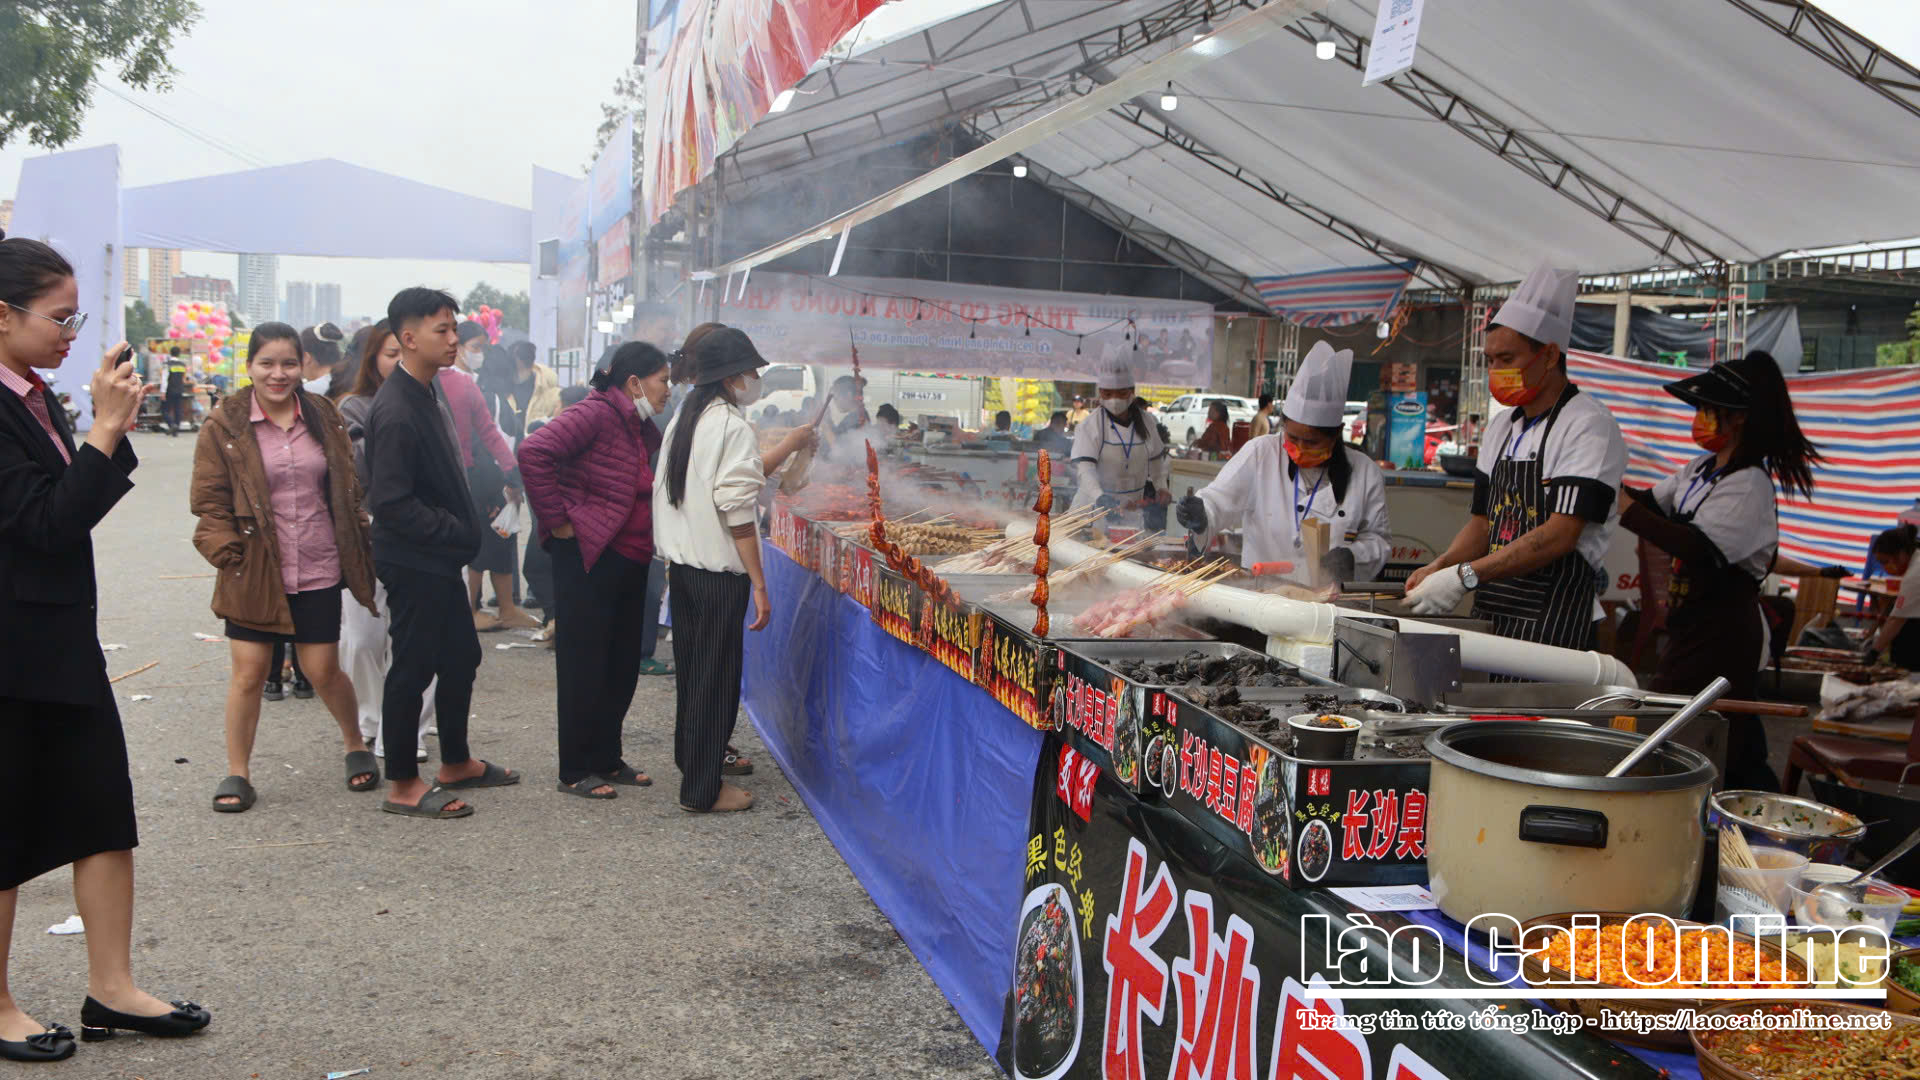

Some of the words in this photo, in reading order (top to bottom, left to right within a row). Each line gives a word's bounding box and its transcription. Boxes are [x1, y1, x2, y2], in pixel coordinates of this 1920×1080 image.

[1065, 671, 1117, 753] 长沙臭豆腐
[1180, 728, 1257, 836] 长沙臭豆腐
[1341, 788, 1429, 861] 长沙臭
[1025, 824, 1095, 940] 黑色经典
